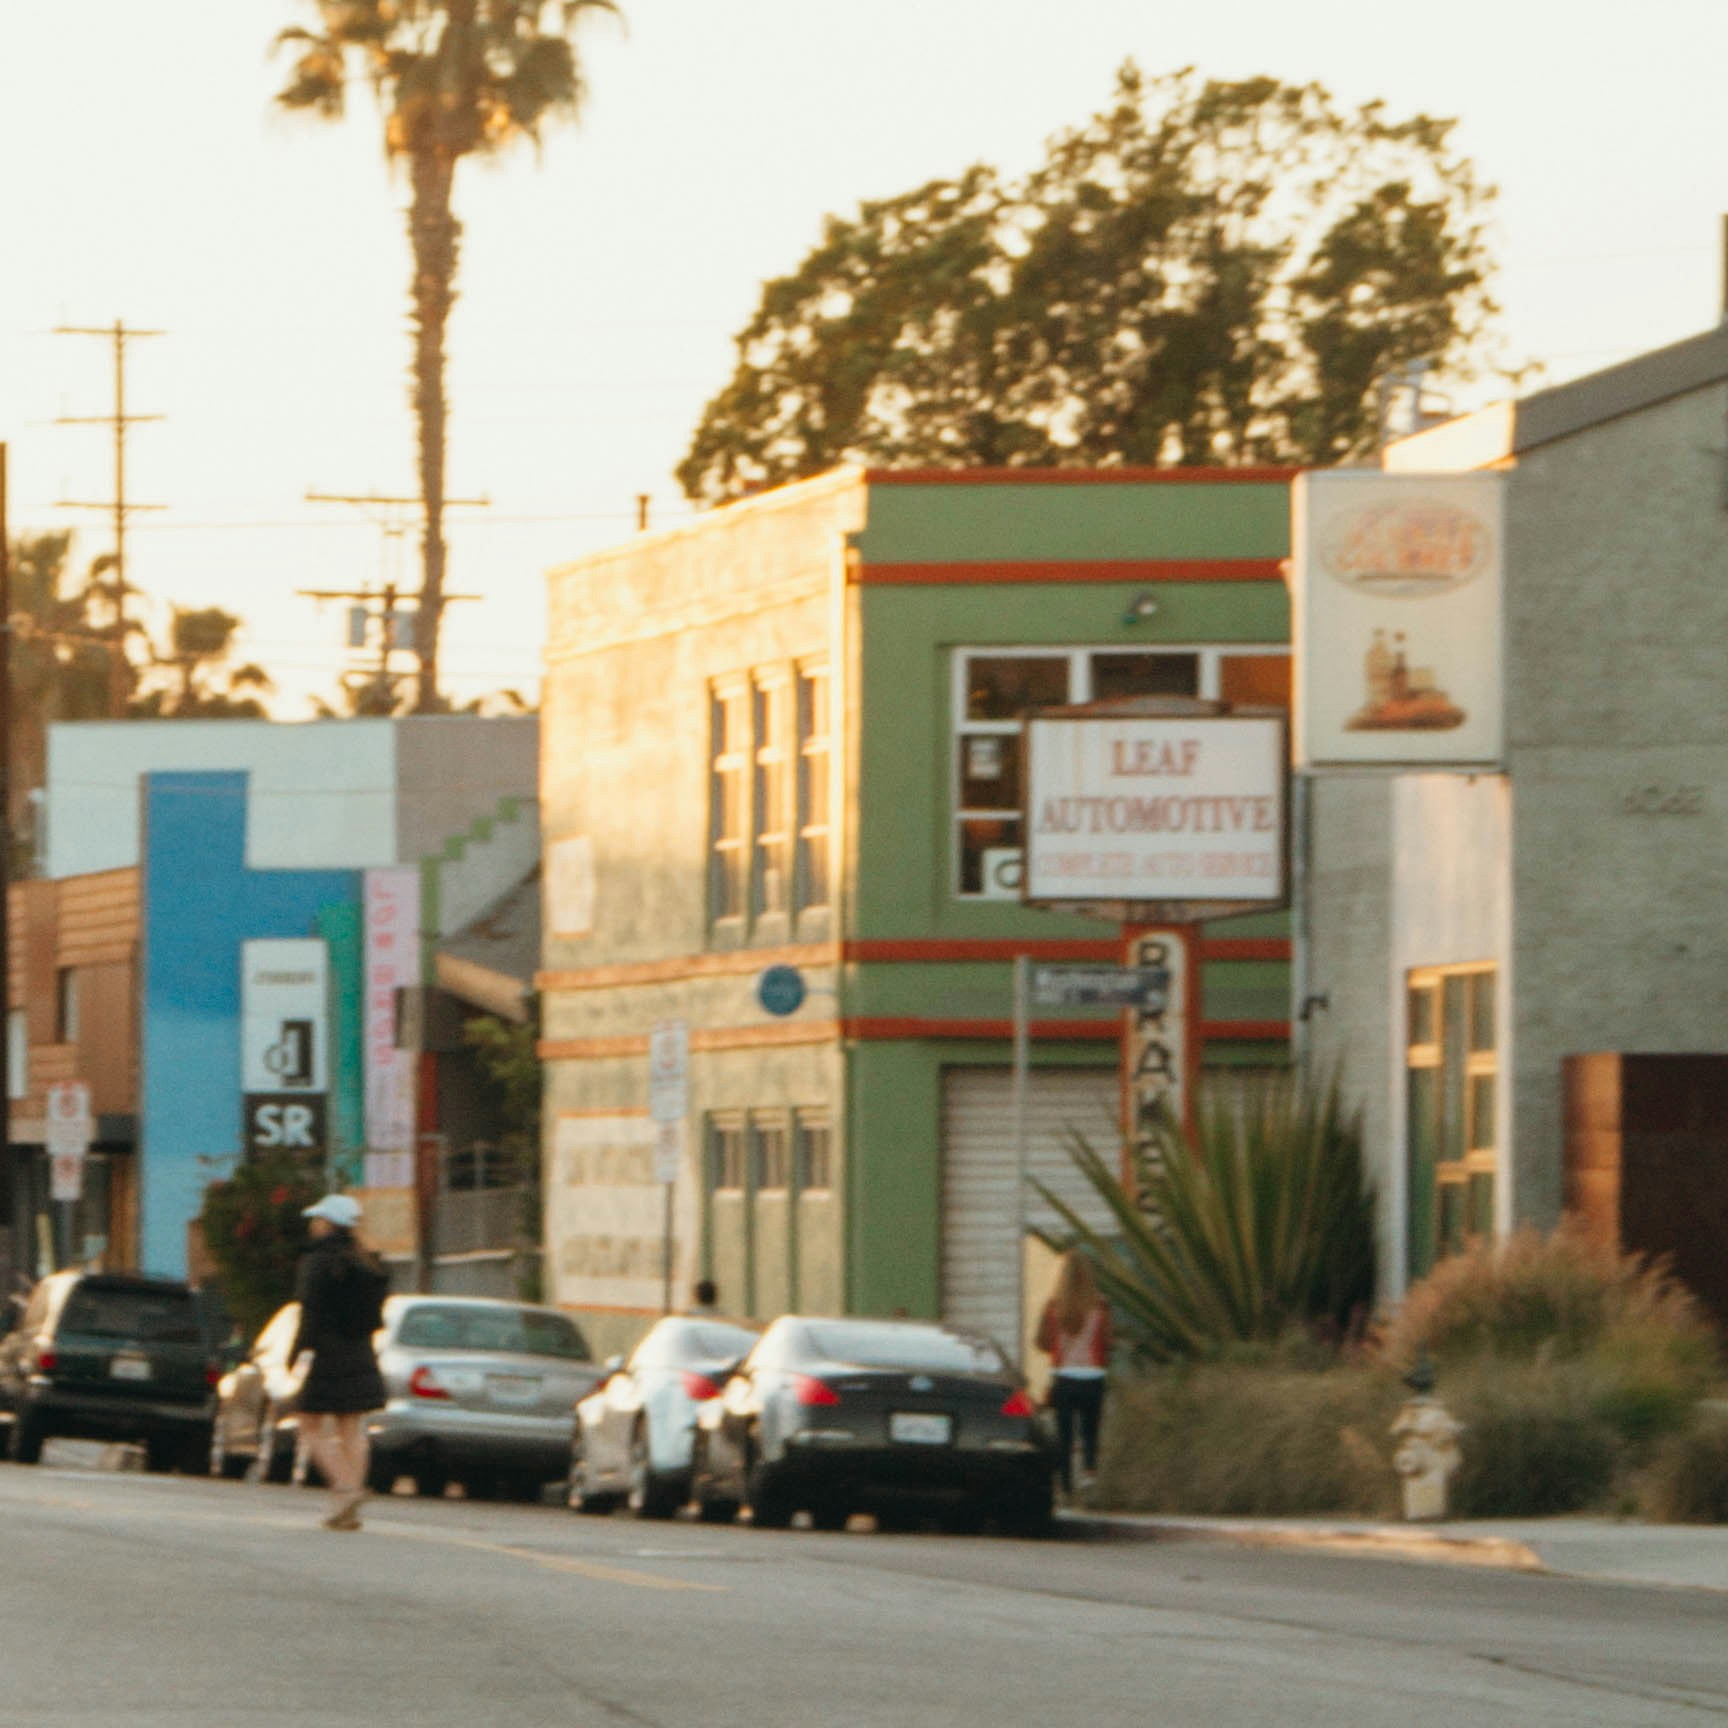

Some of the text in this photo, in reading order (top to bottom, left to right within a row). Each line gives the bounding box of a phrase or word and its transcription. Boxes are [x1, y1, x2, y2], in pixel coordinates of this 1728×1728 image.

[1110, 739, 1199, 776] LEAF
[1037, 795, 1275, 833] AUTOMOTIVE
[254, 1103, 315, 1148] SR
